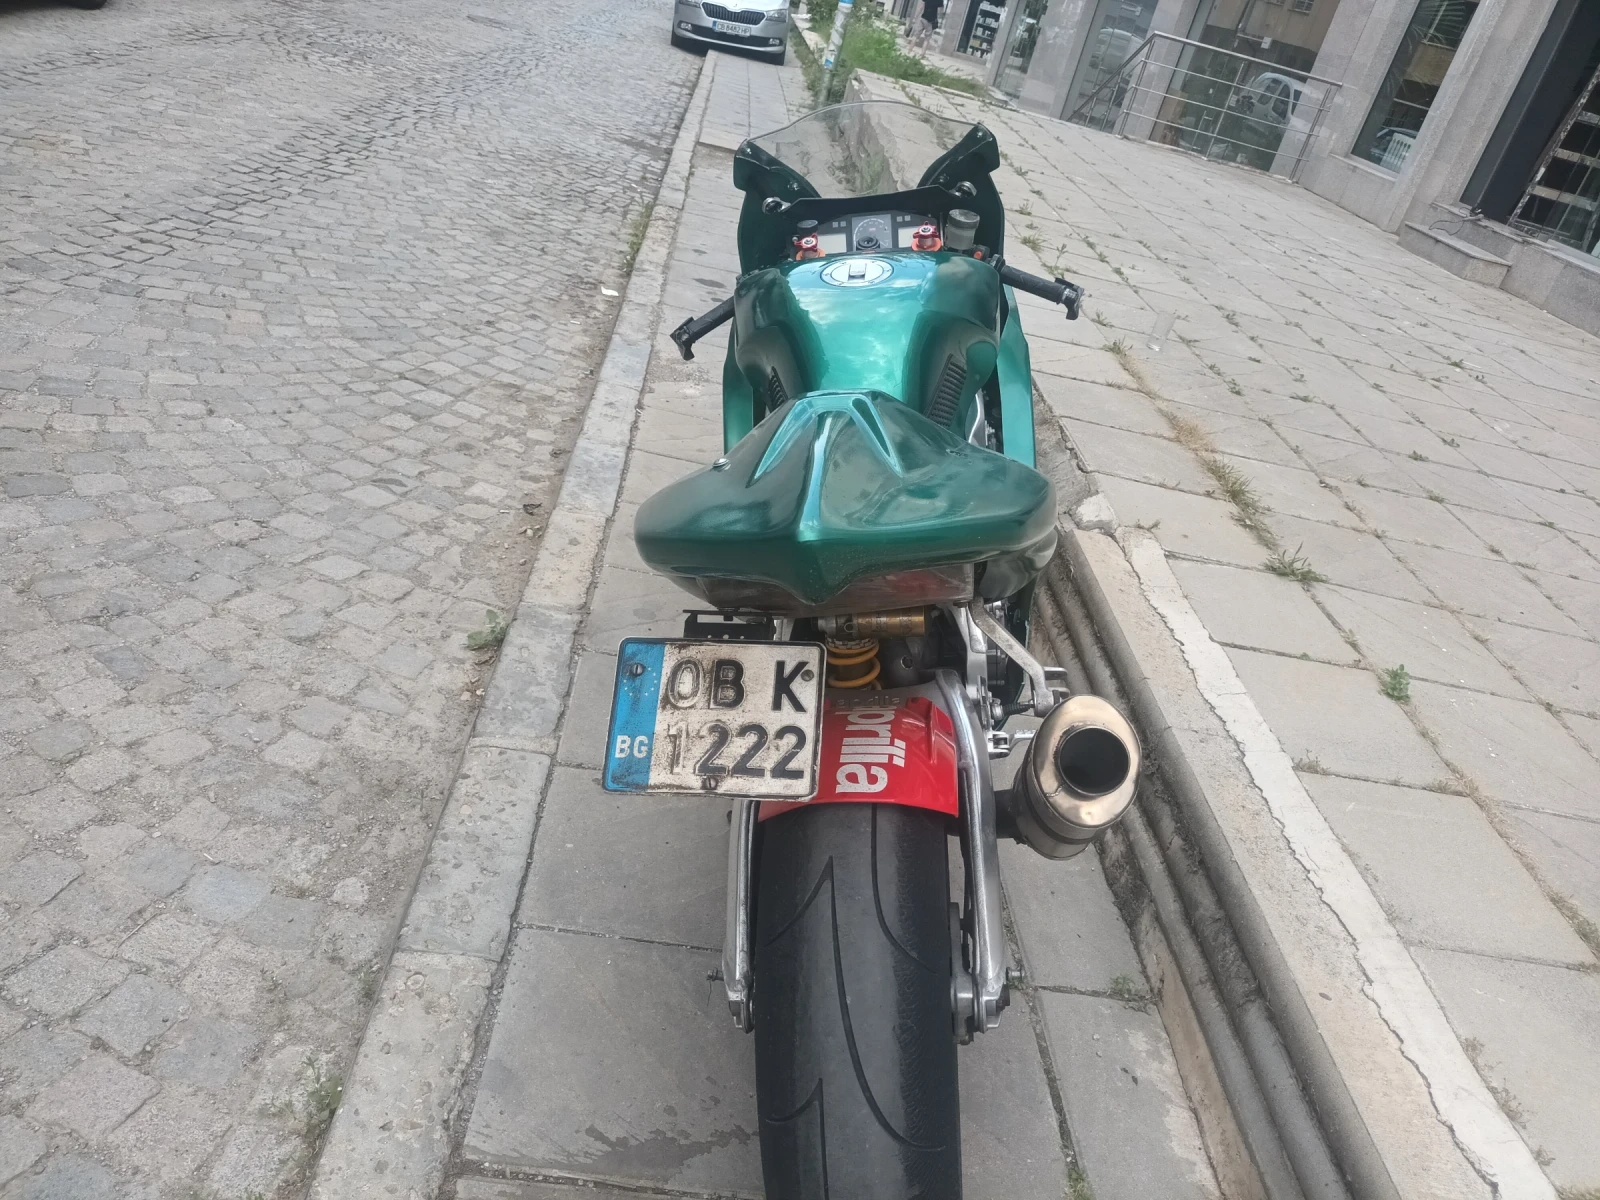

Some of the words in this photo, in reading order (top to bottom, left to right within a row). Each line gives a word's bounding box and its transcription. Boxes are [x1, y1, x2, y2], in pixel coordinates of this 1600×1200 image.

[666, 657, 745, 709] OB
[771, 660, 810, 713] K
[615, 734, 649, 759] BG
[667, 719, 807, 779] 1222
